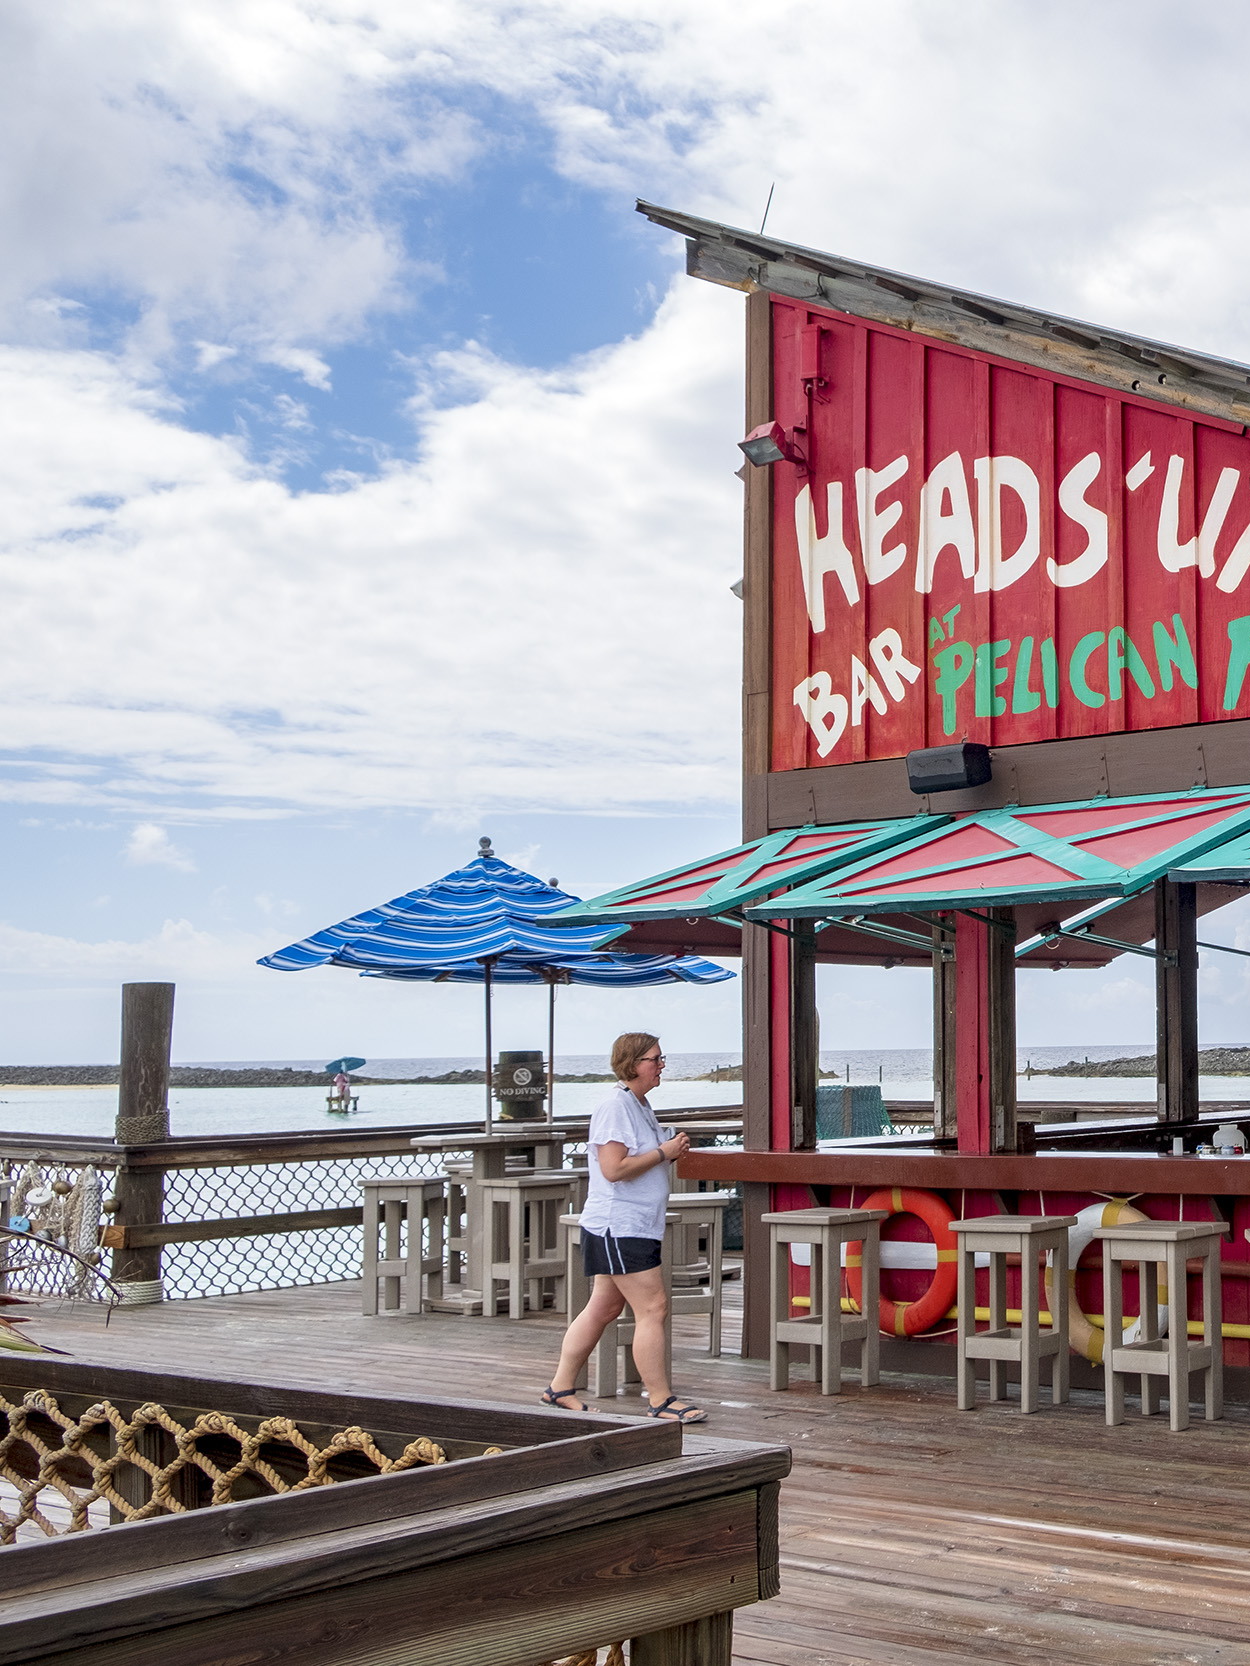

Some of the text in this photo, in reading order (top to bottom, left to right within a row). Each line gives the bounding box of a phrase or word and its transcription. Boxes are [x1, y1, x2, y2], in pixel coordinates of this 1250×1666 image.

[929, 603, 962, 649] AT
[793, 627, 922, 759] BAR
[934, 613, 1199, 737] PELICAN
[499, 1086, 546, 1096] NO DIVING
